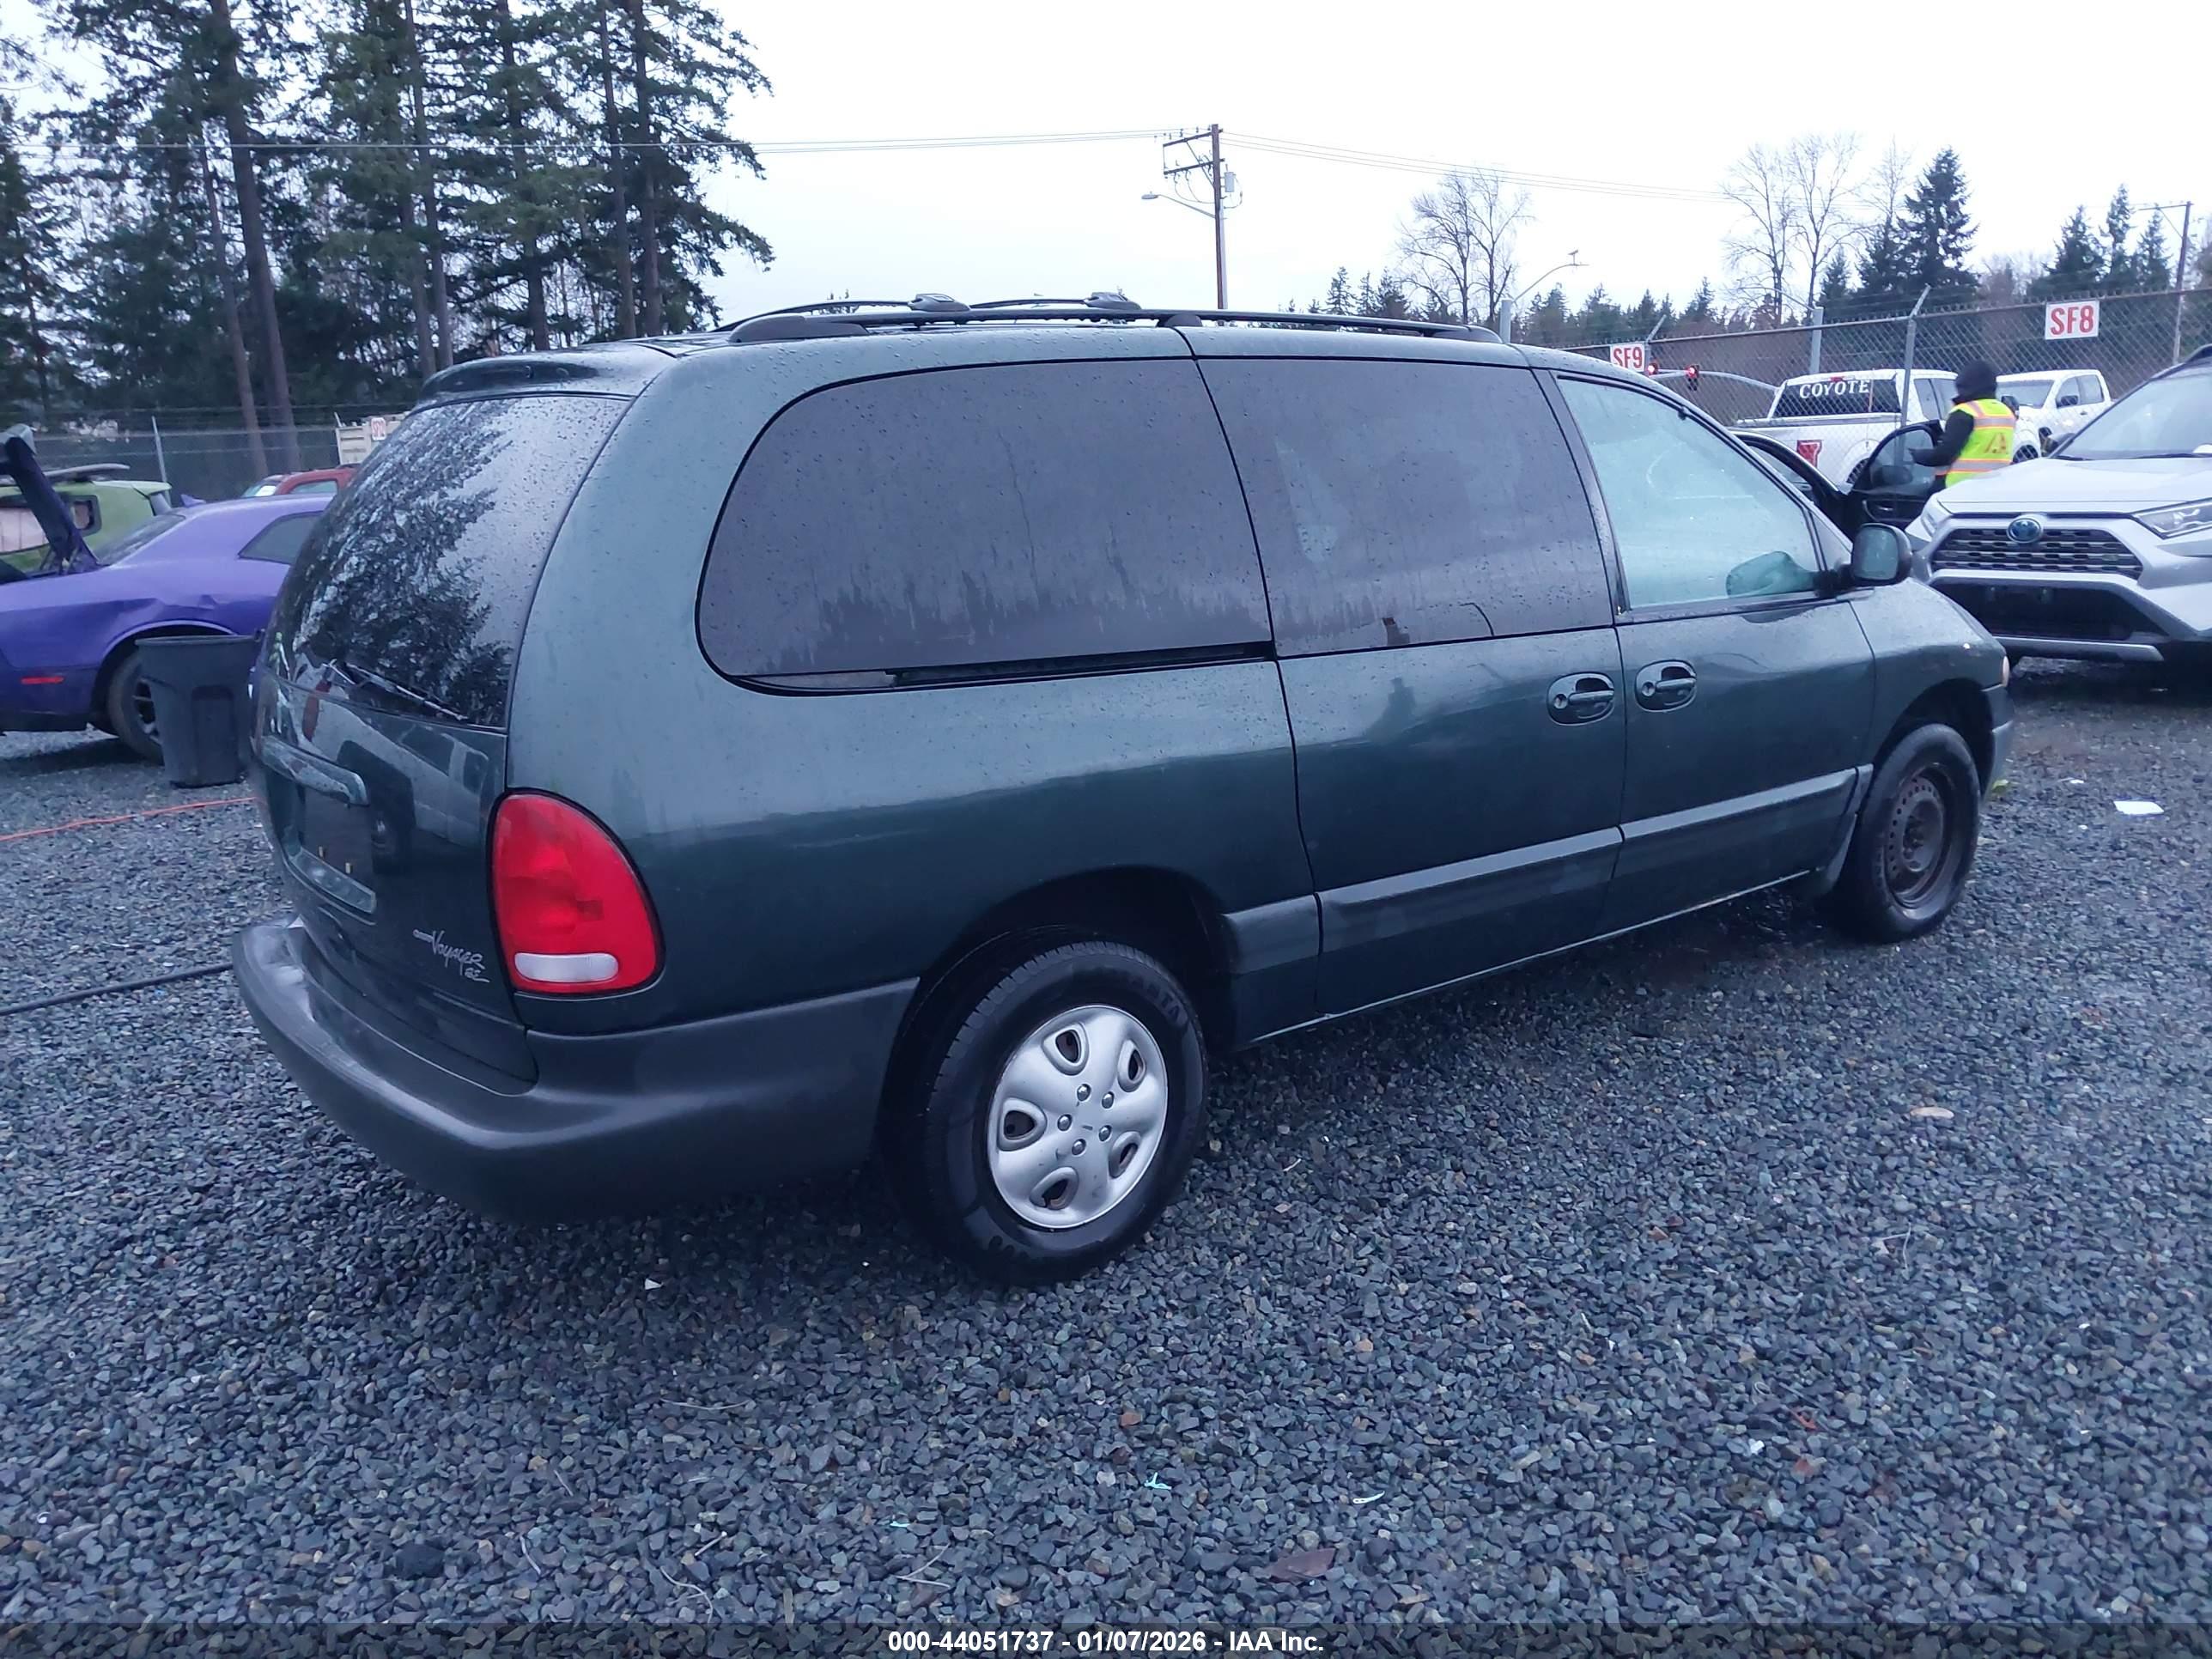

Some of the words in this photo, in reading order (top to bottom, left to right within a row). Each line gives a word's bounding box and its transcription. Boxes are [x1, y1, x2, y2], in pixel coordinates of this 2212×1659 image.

[2050, 305, 2094, 335] SF8
[1613, 346, 1642, 368] SF9
[1799, 380, 1870, 398] COYOTE
